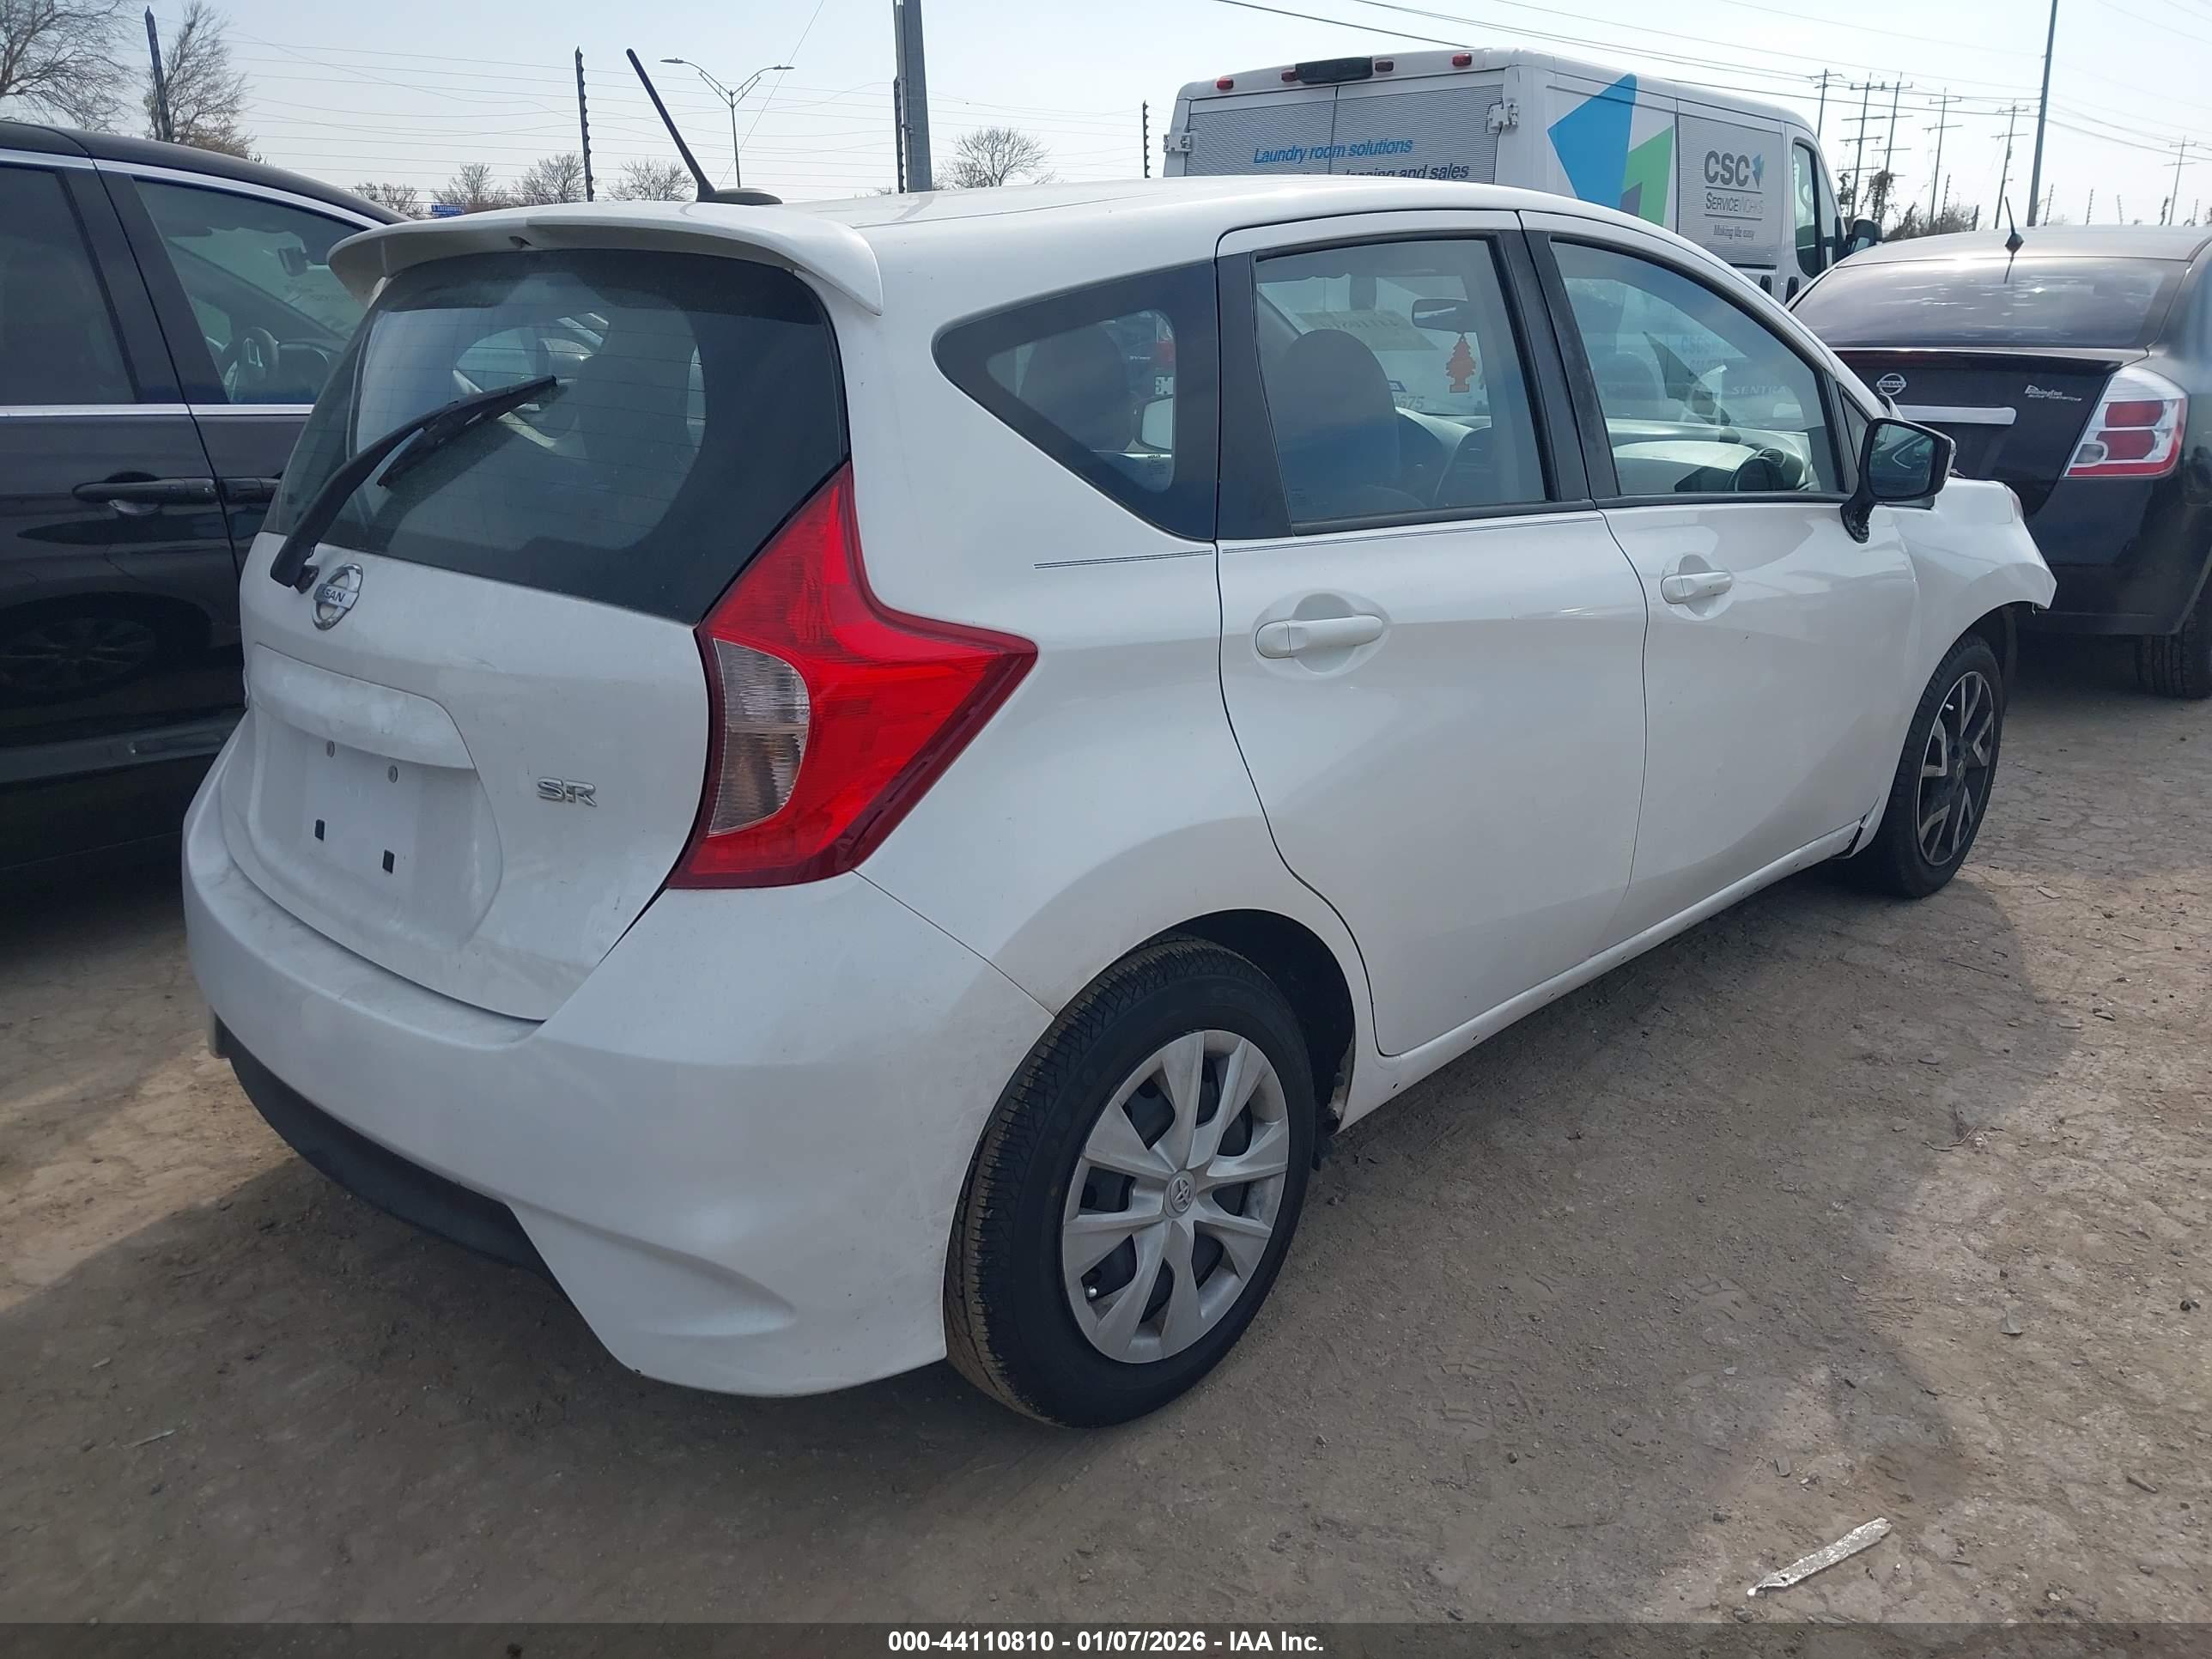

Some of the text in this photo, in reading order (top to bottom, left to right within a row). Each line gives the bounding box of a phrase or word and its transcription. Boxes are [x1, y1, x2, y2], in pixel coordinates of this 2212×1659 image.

[1254, 137, 1413, 164] Laundry room solutions
[1401, 162, 1470, 180] and sales
[1705, 150, 1750, 187] CSC
[538, 776, 598, 807] SR
